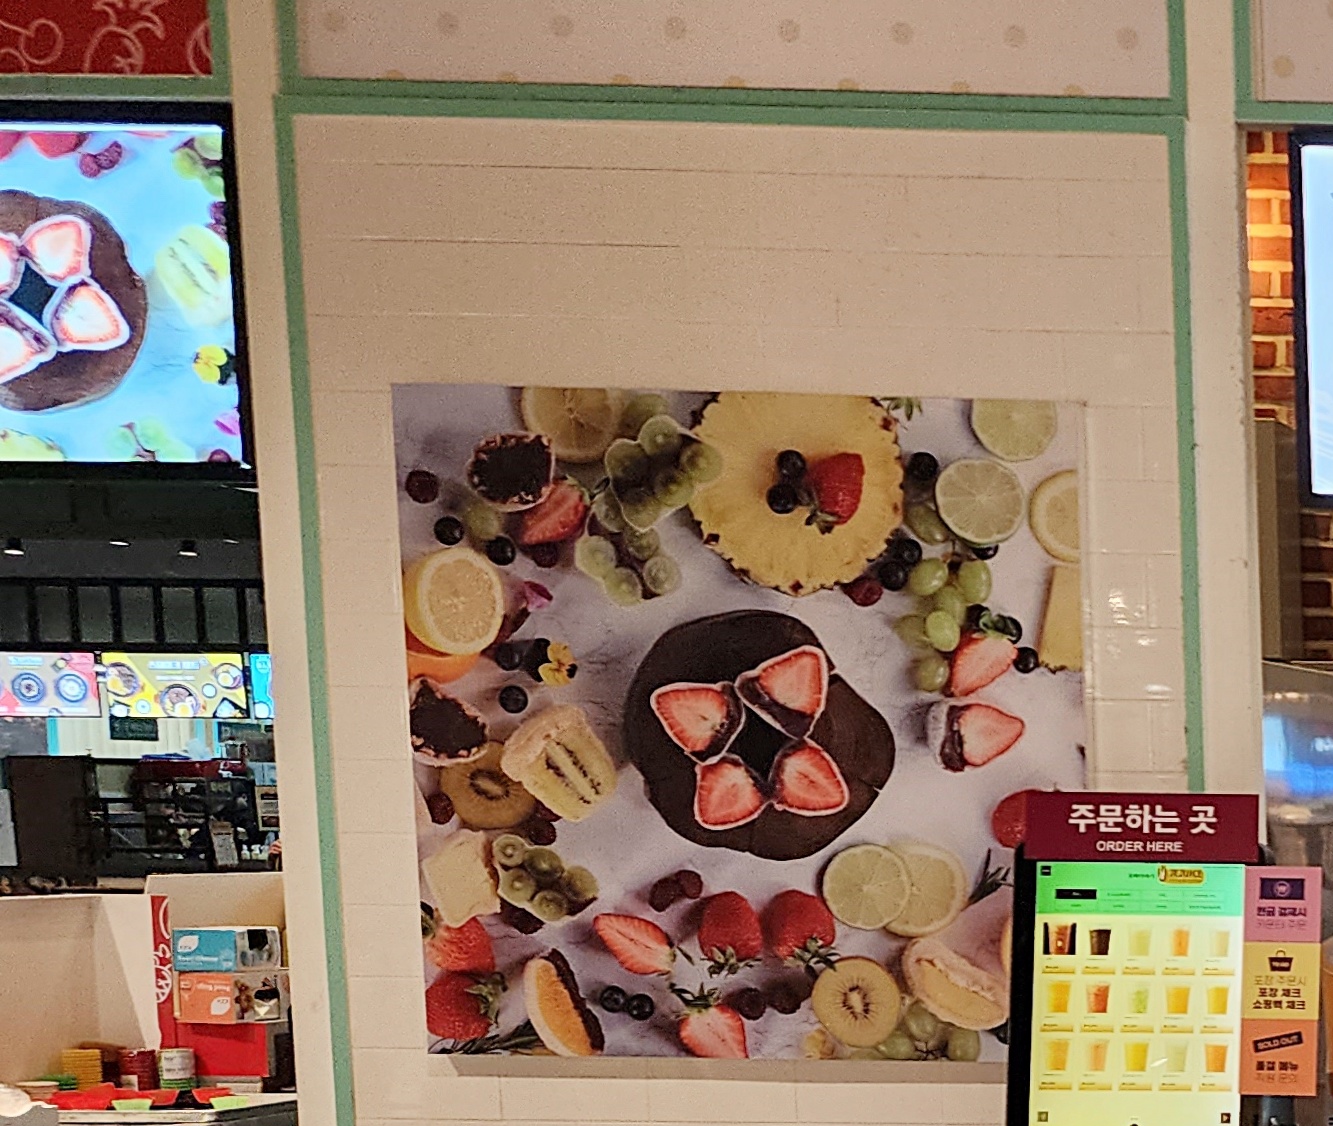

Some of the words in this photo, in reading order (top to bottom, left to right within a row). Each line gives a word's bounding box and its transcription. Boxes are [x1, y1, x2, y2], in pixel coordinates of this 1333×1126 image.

[1068, 804, 1180, 834] 주문하는
[1190, 806, 1218, 835] 곳
[1096, 840, 1143, 853] ORDER
[1146, 841, 1183, 853] HERE
